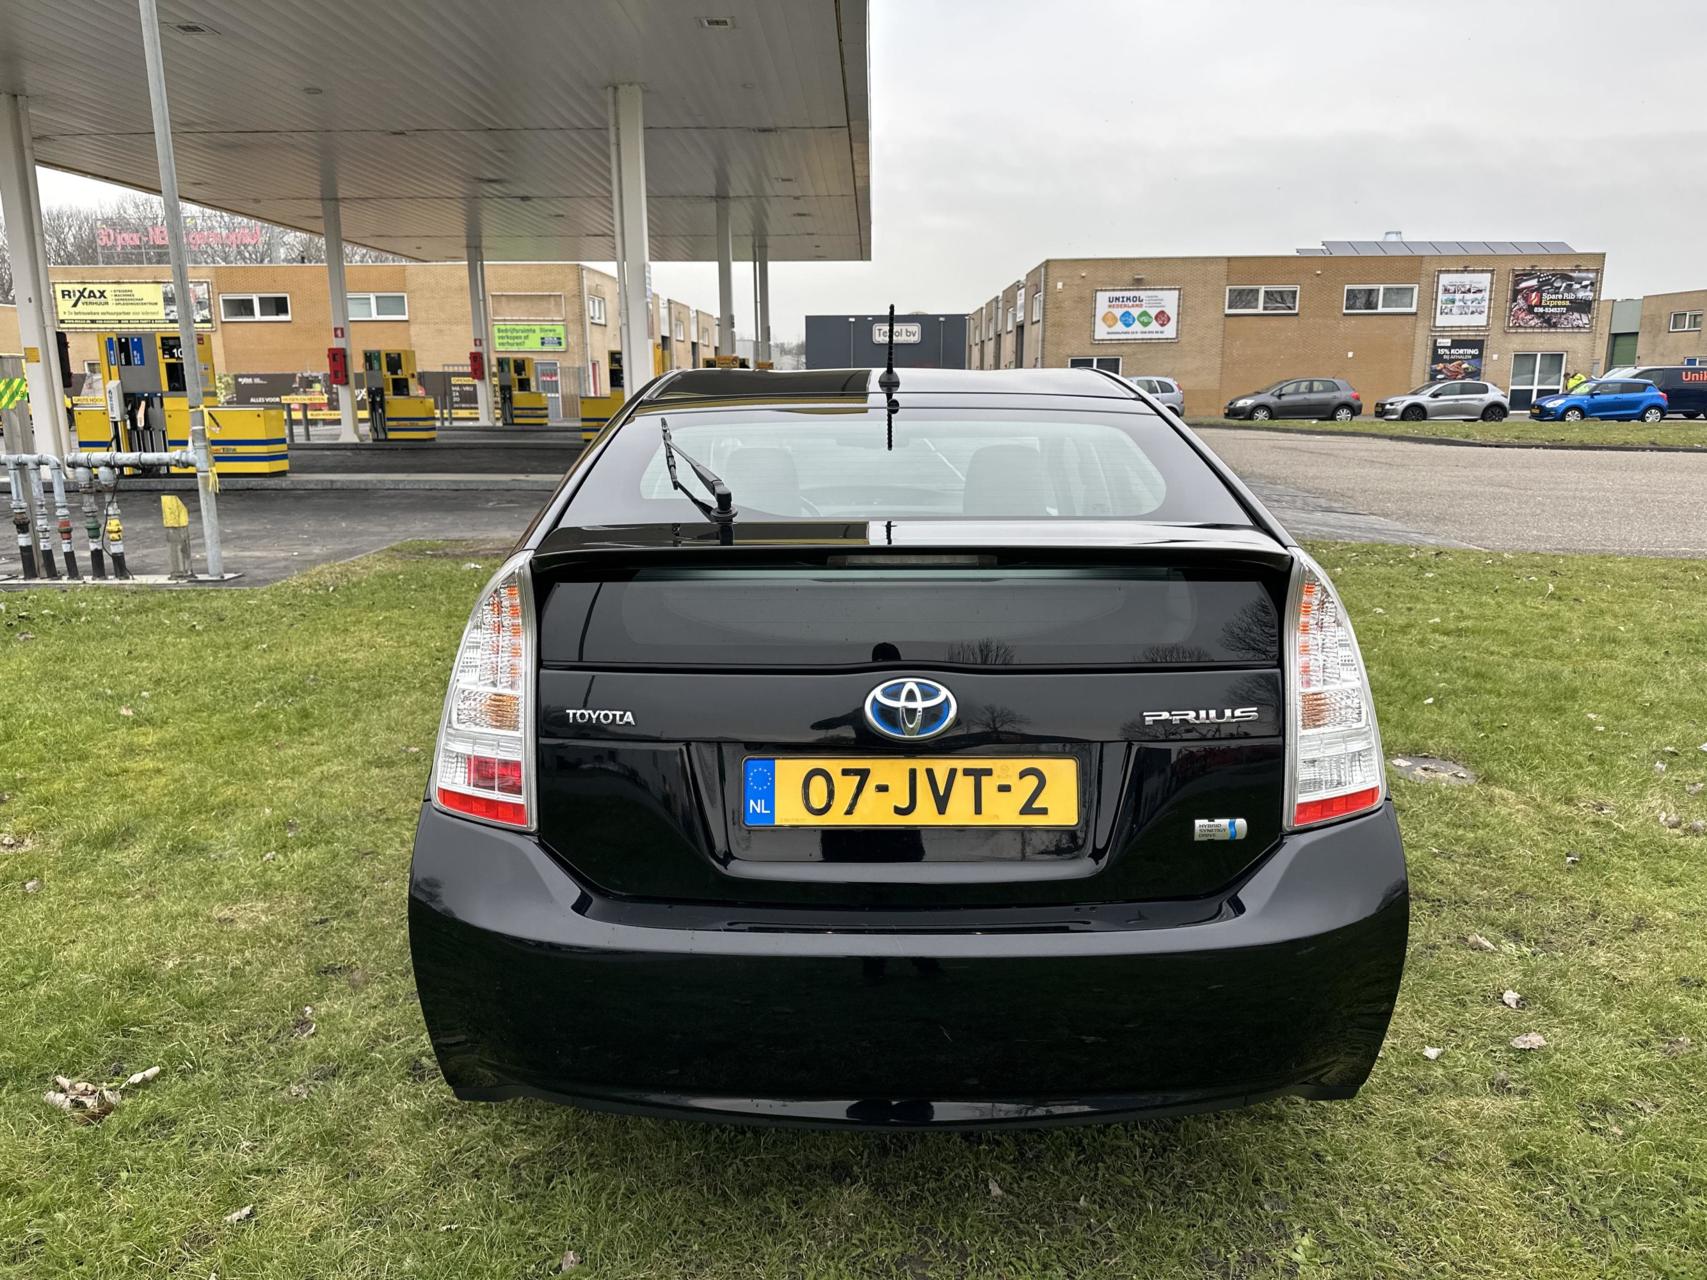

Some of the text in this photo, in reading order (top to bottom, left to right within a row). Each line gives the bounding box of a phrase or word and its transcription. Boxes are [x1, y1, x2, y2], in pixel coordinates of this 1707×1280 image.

[61, 287, 108, 308] RIXAX
[1108, 295, 1144, 303] UNIKOL
[1542, 292, 1576, 301] Spare Rib
[905, 328, 917, 338] bv
[565, 709, 636, 726] TOYOTA
[1142, 706, 1259, 725] PRIUS
[801, 767, 1049, 816] 07-JVT-2
[749, 799, 771, 814] NL
